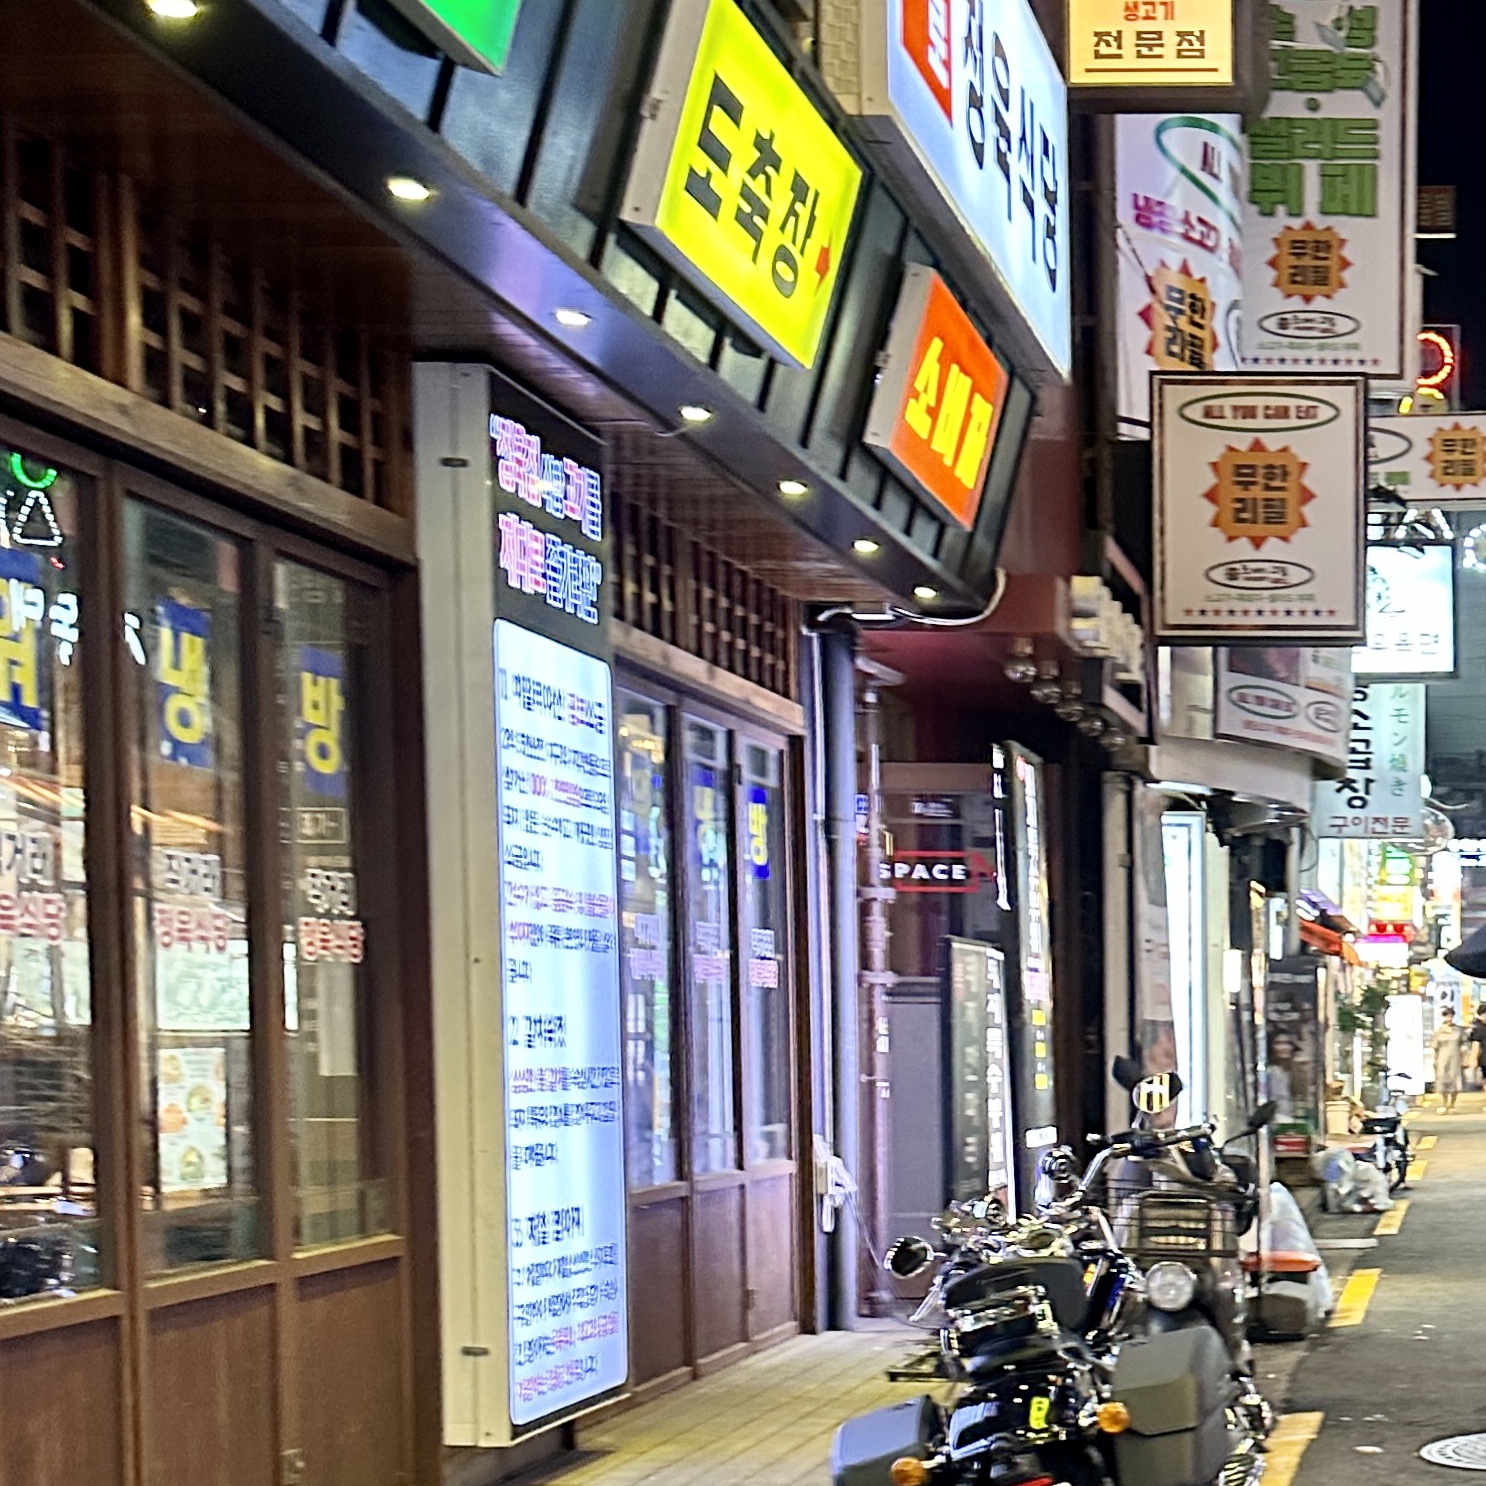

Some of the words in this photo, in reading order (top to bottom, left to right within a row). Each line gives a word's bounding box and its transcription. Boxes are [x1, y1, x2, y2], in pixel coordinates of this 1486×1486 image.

[1123, 1, 1175, 21] 생고기
[1093, 30, 1205, 59] 전문점
[963, 0, 1057, 293] 정육식당
[1249, 117, 1378, 159] 샐러드
[684, 72, 819, 298] 도축장
[1289, 239, 1332, 260] 무한
[1203, 405, 1226, 419] ALL
[1231, 405, 1257, 419] YOU
[1263, 405, 1290, 419] CAN
[1296, 405, 1319, 419] EAT
[1441, 438, 1478, 455] 무한
[1232, 463, 1289, 491] 무한
[1232, 497, 1288, 525] 리필
[160, 627, 208, 745] 냉
[302, 668, 346, 774] 방
[1328, 816, 1411, 835] 구이전문
[879, 863, 967, 881] SPACE
